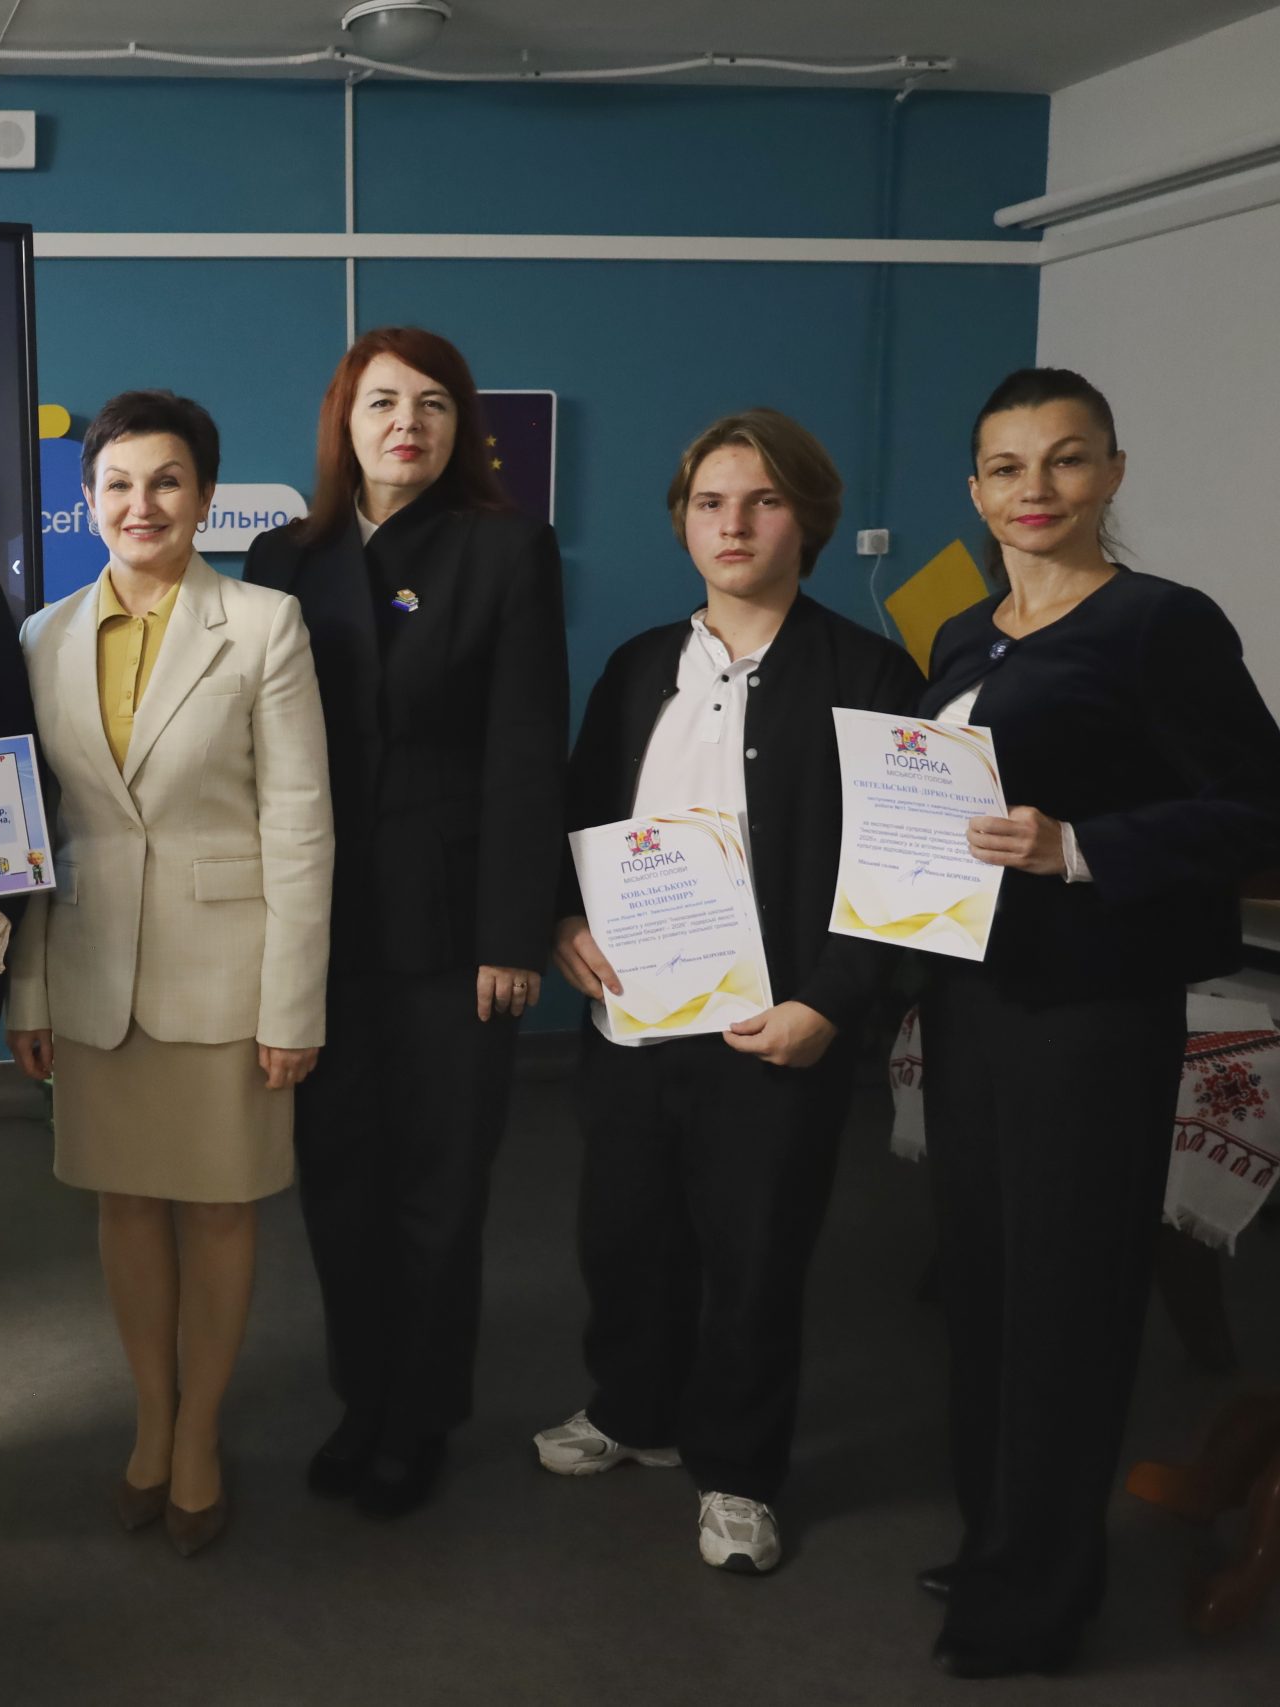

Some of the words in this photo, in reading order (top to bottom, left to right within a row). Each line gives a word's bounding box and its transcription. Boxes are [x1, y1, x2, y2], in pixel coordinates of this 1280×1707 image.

[41, 502, 84, 534] cef
[211, 504, 288, 529] ільно
[885, 753, 951, 775] ПОДЯКА
[621, 850, 685, 874] ПОДЯКА
